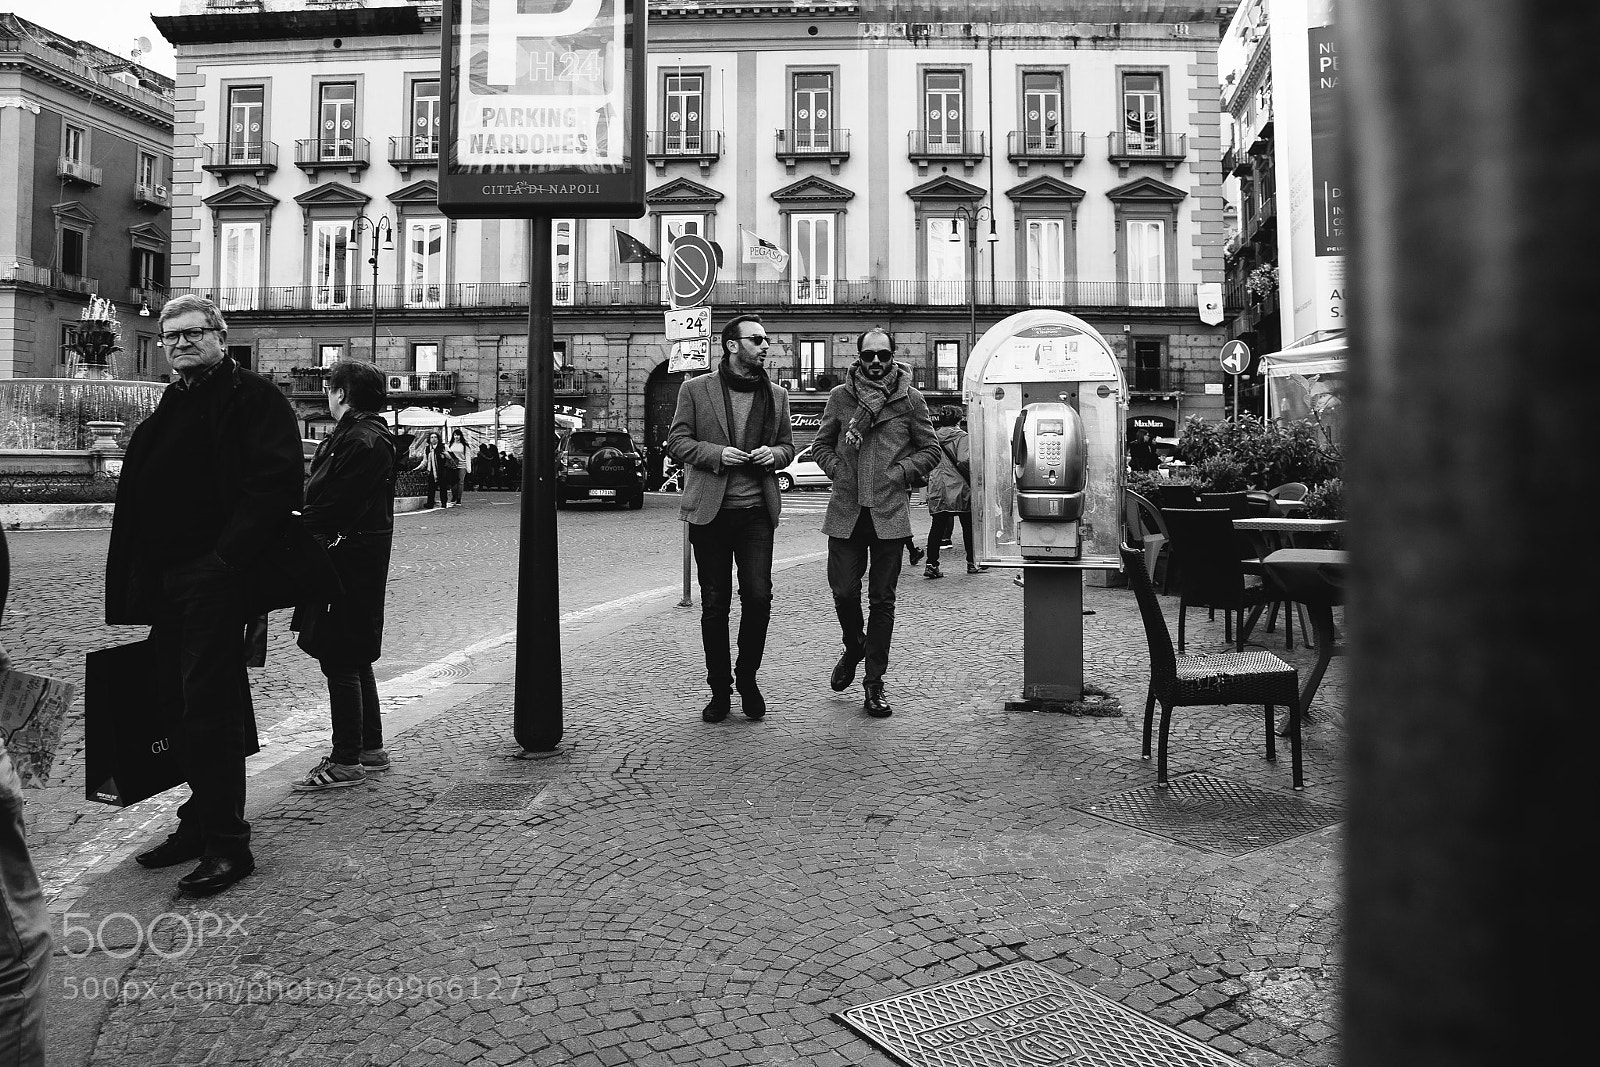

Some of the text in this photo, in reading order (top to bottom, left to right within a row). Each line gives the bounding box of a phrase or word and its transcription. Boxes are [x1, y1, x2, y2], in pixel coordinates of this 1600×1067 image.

[487, 0, 602, 85] P
[482, 107, 576, 128] PARKING
[470, 134, 588, 154] NARDONES
[529, 184, 543, 194] DI
[549, 184, 600, 194] NAPOLI
[749, 246, 783, 263] PEGASO
[1133, 419, 1164, 428] MaxMara
[151, 737, 170, 754] GU
[920, 1021, 992, 1047] BOCCA
